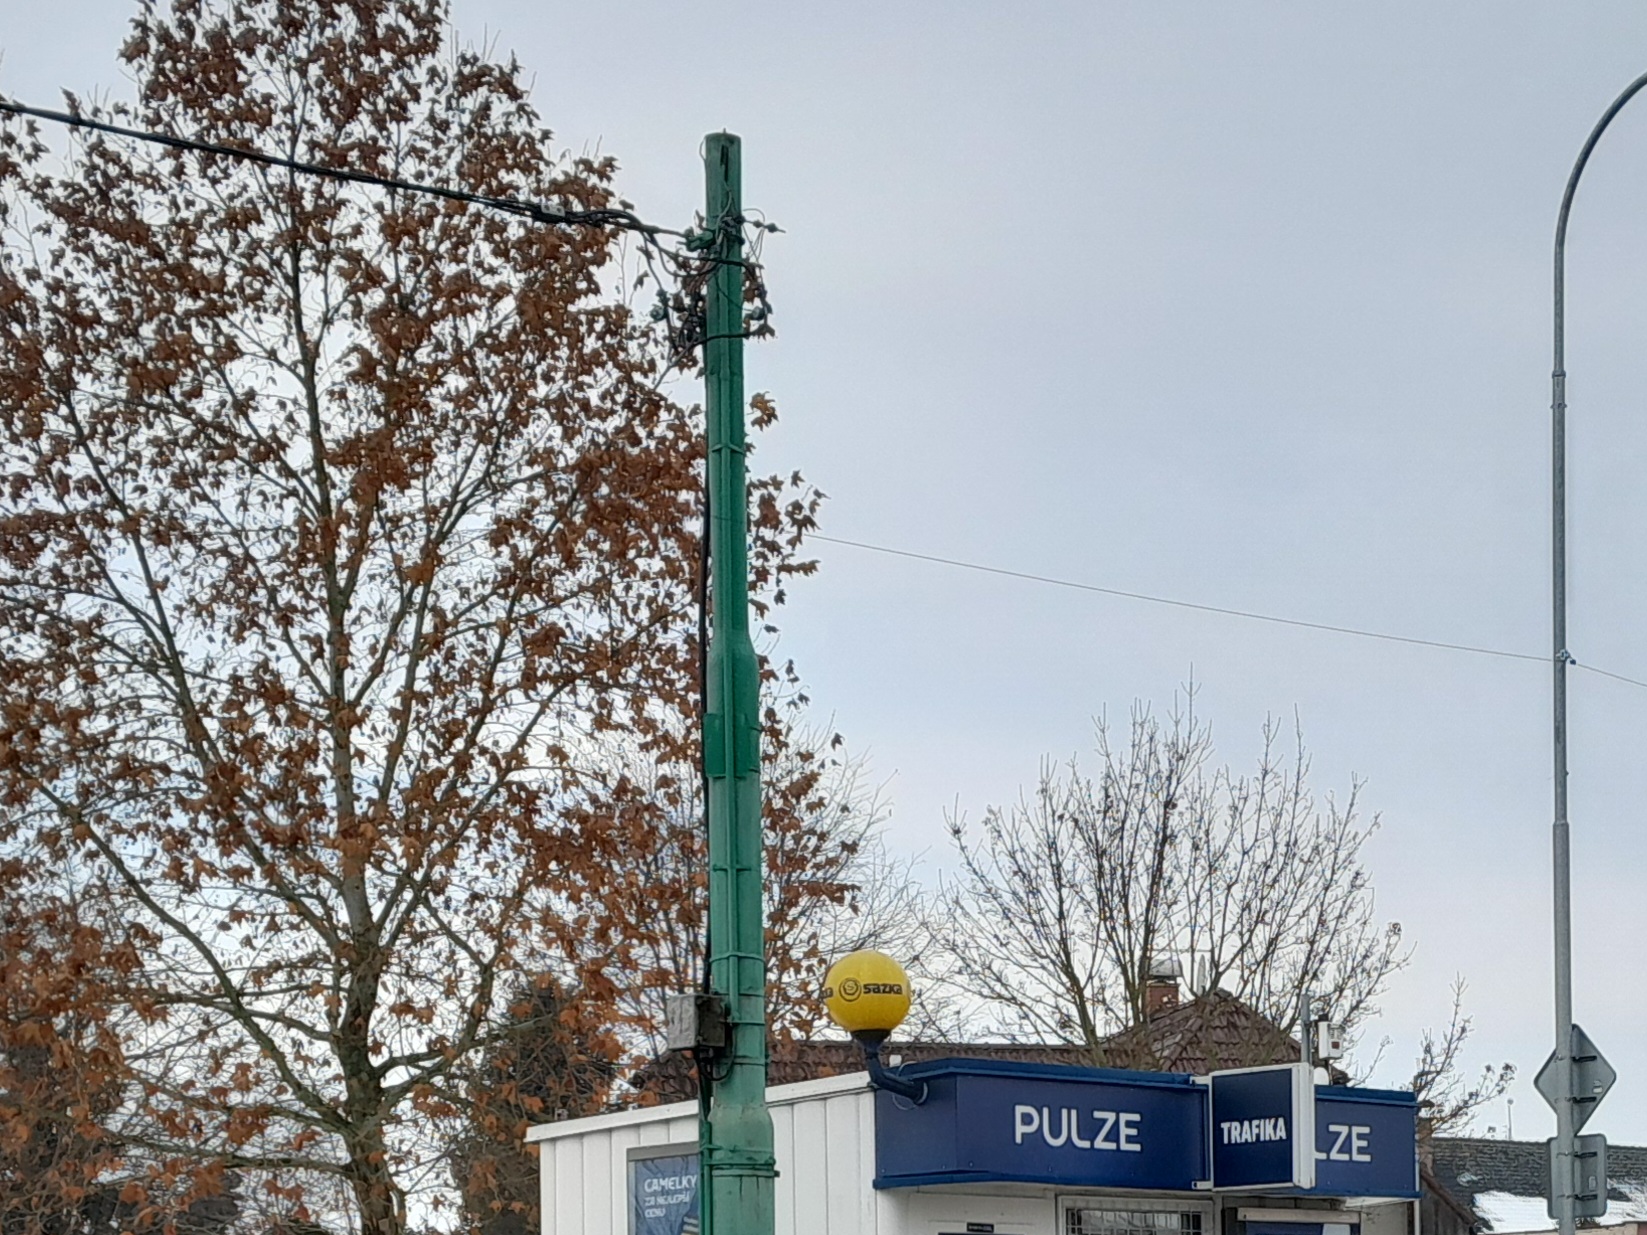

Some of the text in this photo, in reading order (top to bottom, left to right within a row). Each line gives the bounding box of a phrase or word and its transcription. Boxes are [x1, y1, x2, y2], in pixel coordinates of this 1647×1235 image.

[863, 983, 903, 995] sazka
[1014, 1104, 1142, 1152] PULZE
[1220, 1116, 1287, 1145] TRAFIKA
[644, 1175, 697, 1192] CAMELKY
